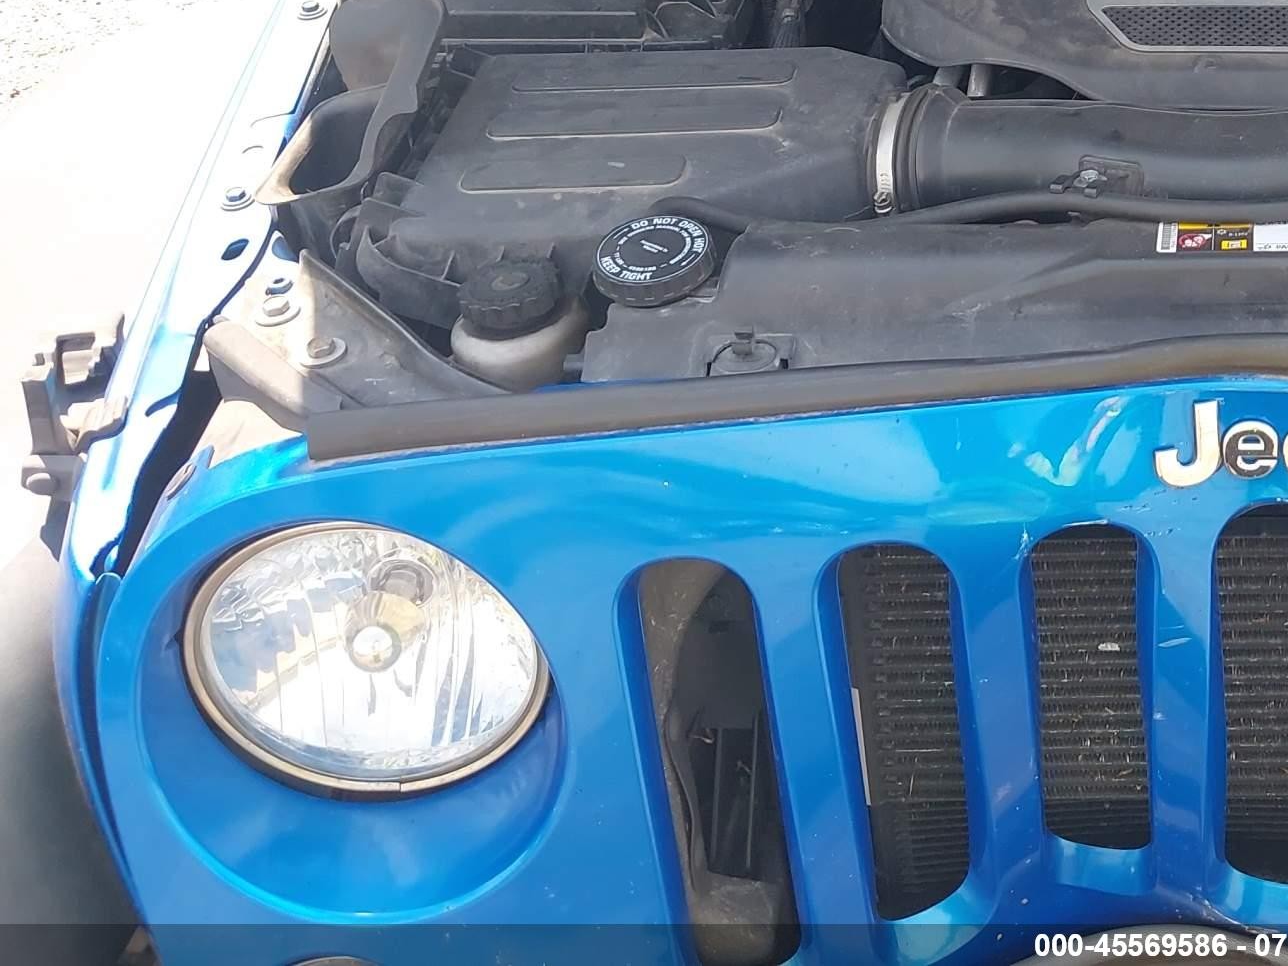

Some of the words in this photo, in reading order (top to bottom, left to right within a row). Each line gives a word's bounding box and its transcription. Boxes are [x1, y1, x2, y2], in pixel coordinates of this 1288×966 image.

[631, 220, 649, 230] DO
[653, 217, 679, 225] NOT
[678, 220, 702, 237] OPEN
[692, 236, 706, 253] HOT
[600, 256, 621, 274] KEEP
[619, 270, 653, 281] TIGHT
